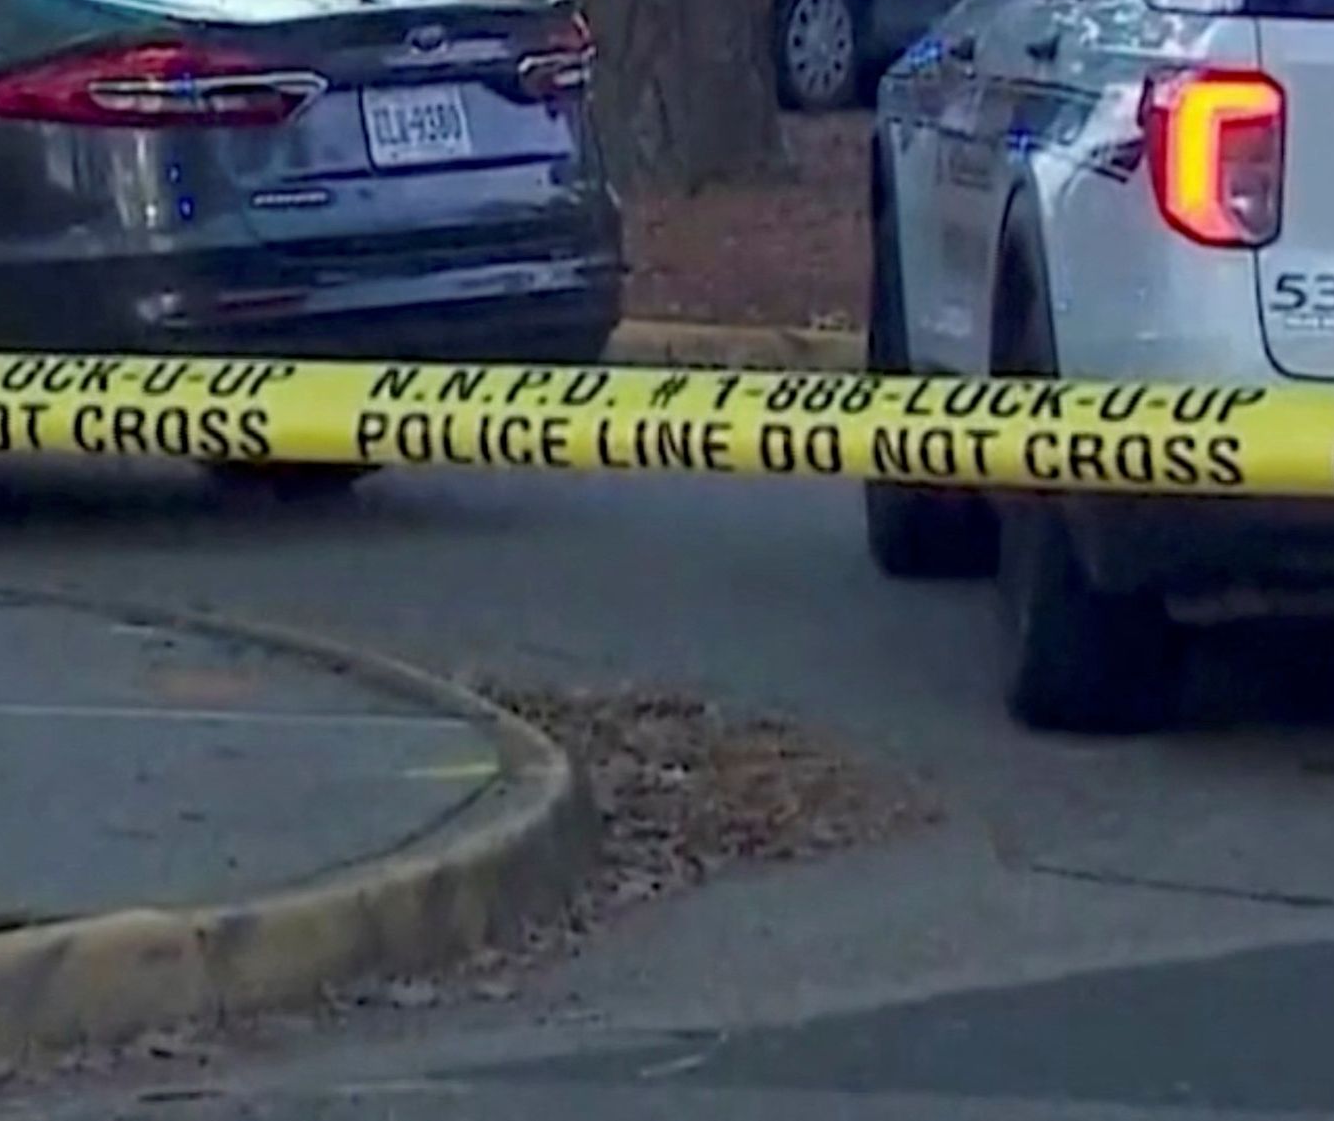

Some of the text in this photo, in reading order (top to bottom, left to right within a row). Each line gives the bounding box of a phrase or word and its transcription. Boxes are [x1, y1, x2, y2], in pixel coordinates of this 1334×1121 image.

[370, 368, 1266, 424] N.N.P.D. # 1-888-LOCK-U-UP
[74, 404, 272, 458] CROSS
[357, 411, 1246, 487] POLICE LINE DO NOT CROSS
